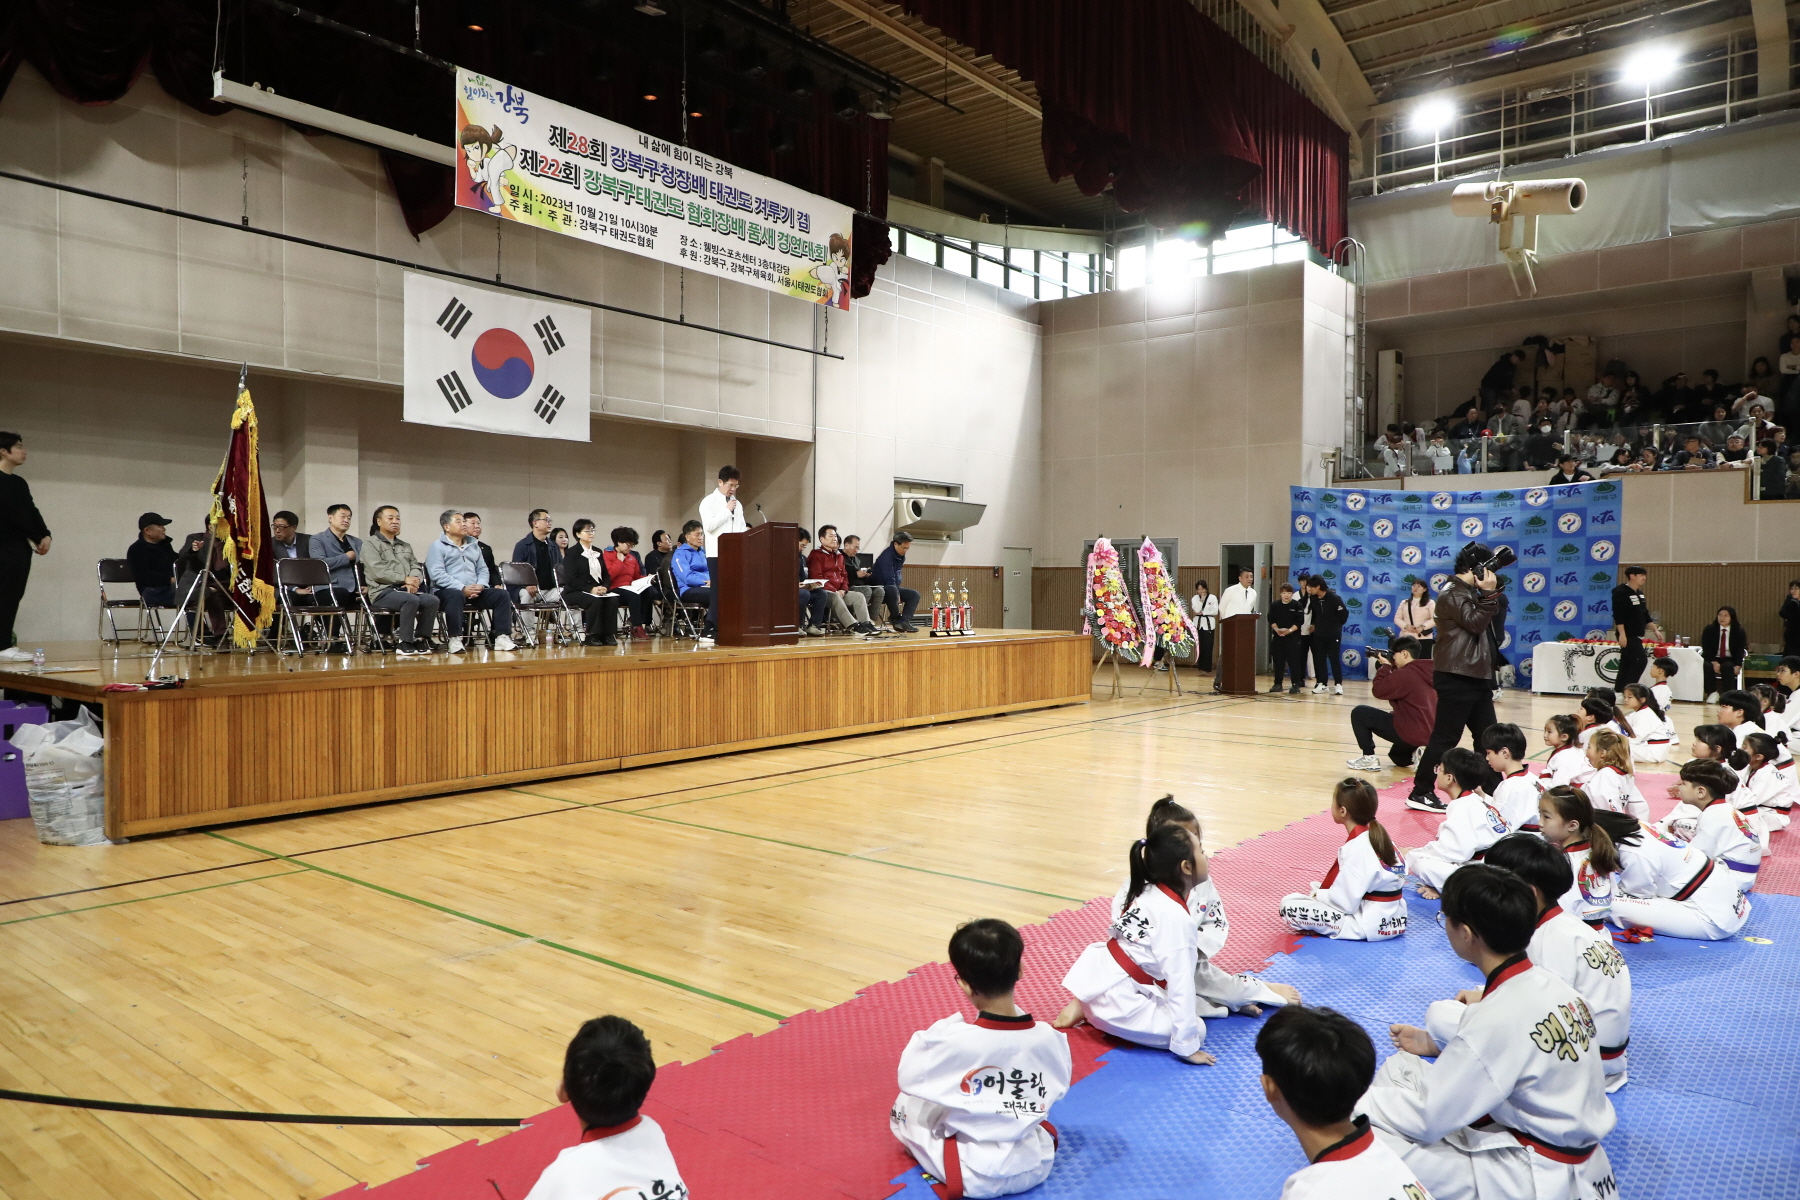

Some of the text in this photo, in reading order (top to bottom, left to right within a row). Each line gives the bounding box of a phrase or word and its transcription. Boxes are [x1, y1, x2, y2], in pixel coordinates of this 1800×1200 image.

[495, 85, 529, 124] 강북
[639, 134, 733, 179] 내 삶에 힘이 되는 강북
[549, 124, 810, 233] 제28회 강북구청장배 태권도 겨루기 겸
[519, 148, 829, 265] 제22회 강북구태권도 협회장배 품새 경연대회
[540, 193, 573, 213] 2023년
[576, 204, 596, 220] 10월
[598, 211, 618, 226] 21일
[620, 217, 658, 238] 10시30분
[579, 218, 608, 236] 강북구
[609, 227, 654, 249] 태권도협회
[703, 241, 757, 266] 웰빙스포츠센터
[758, 258, 790, 276] 3층대강당
[703, 255, 729, 271] 강북구,
[730, 261, 776, 284] 강북구체육회,
[777, 274, 829, 299] 서울시태권도협회
[1294, 490, 1312, 502] KTA
[1462, 491, 1483, 502] KTA
[1558, 484, 1582, 497] KTA
[1374, 493, 1393, 505] KTA
[1319, 517, 1338, 529] KTA
[1493, 516, 1514, 530] KTA
[1592, 510, 1616, 524] KTA
[1402, 518, 1421, 531] KTA
[1345, 544, 1364, 557] KTA
[1430, 545, 1451, 558] KTA
[1523, 543, 1546, 557] KTA
[1372, 572, 1391, 584] KTA
[1555, 571, 1579, 585] KTA
[1588, 583, 1611, 591] 강북구
[1587, 600, 1609, 614] KTA
[1343, 623, 1362, 635] KTA
[1520, 629, 1542, 643] KTA
[983, 1067, 1047, 1100] 어울림
[1003, 1101, 1047, 1120] 태권도
